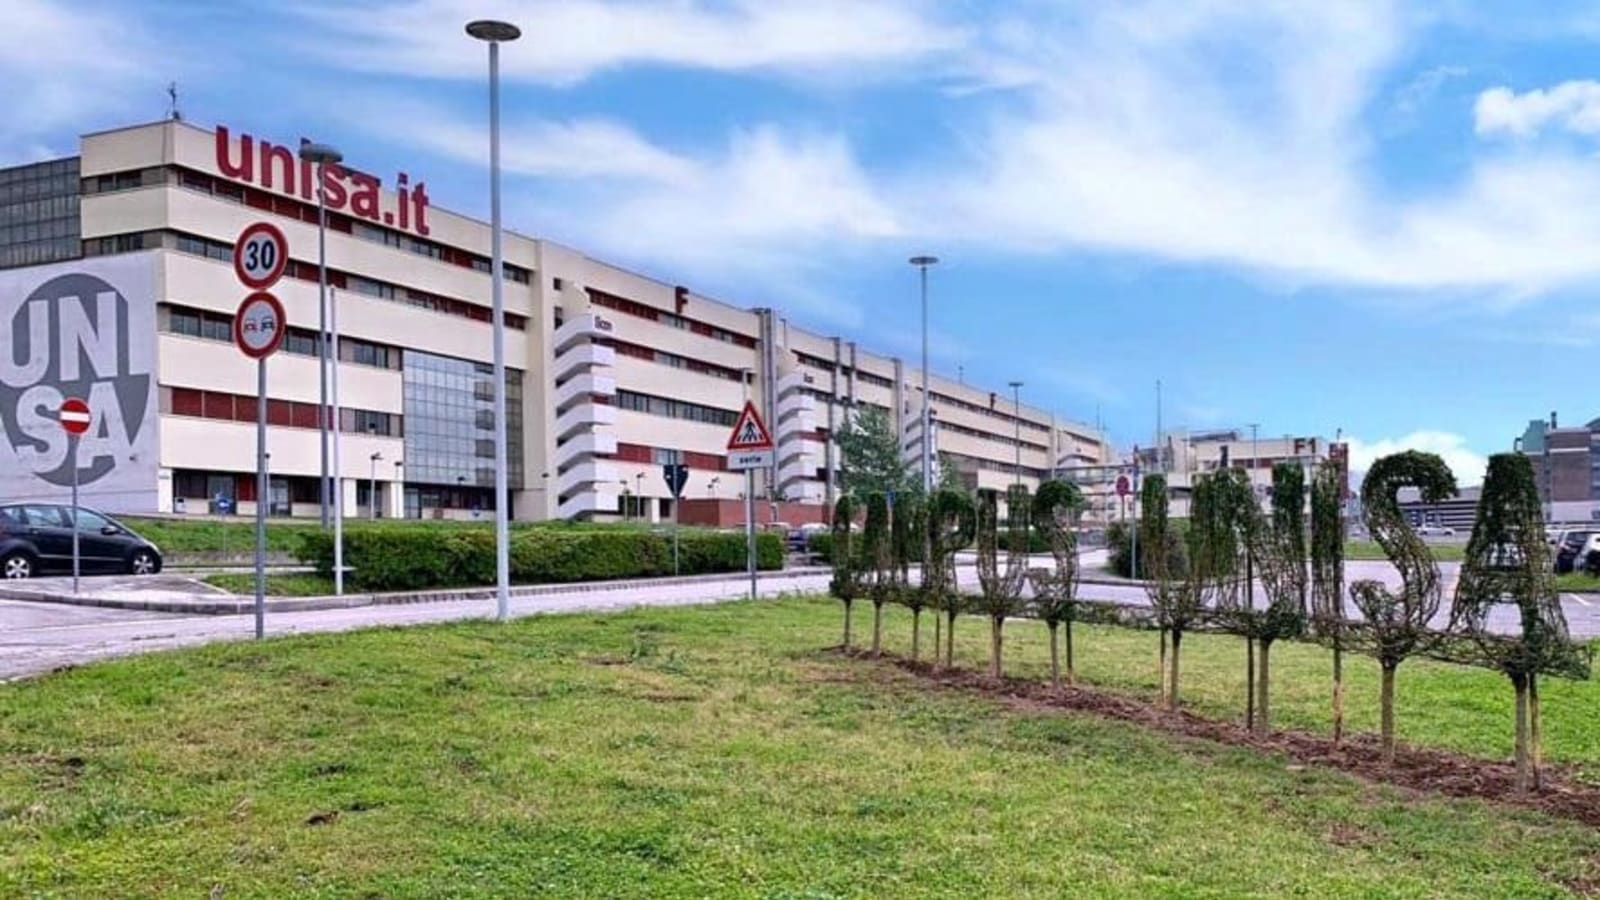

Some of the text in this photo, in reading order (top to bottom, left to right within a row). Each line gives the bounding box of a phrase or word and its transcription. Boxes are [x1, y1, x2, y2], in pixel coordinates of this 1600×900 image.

[216, 124, 430, 236] unisa.it
[245, 240, 275, 271] 30
[675, 286, 689, 314] F
[1294, 437, 1316, 454] F1
[1141, 450, 1580, 668] UNISA
